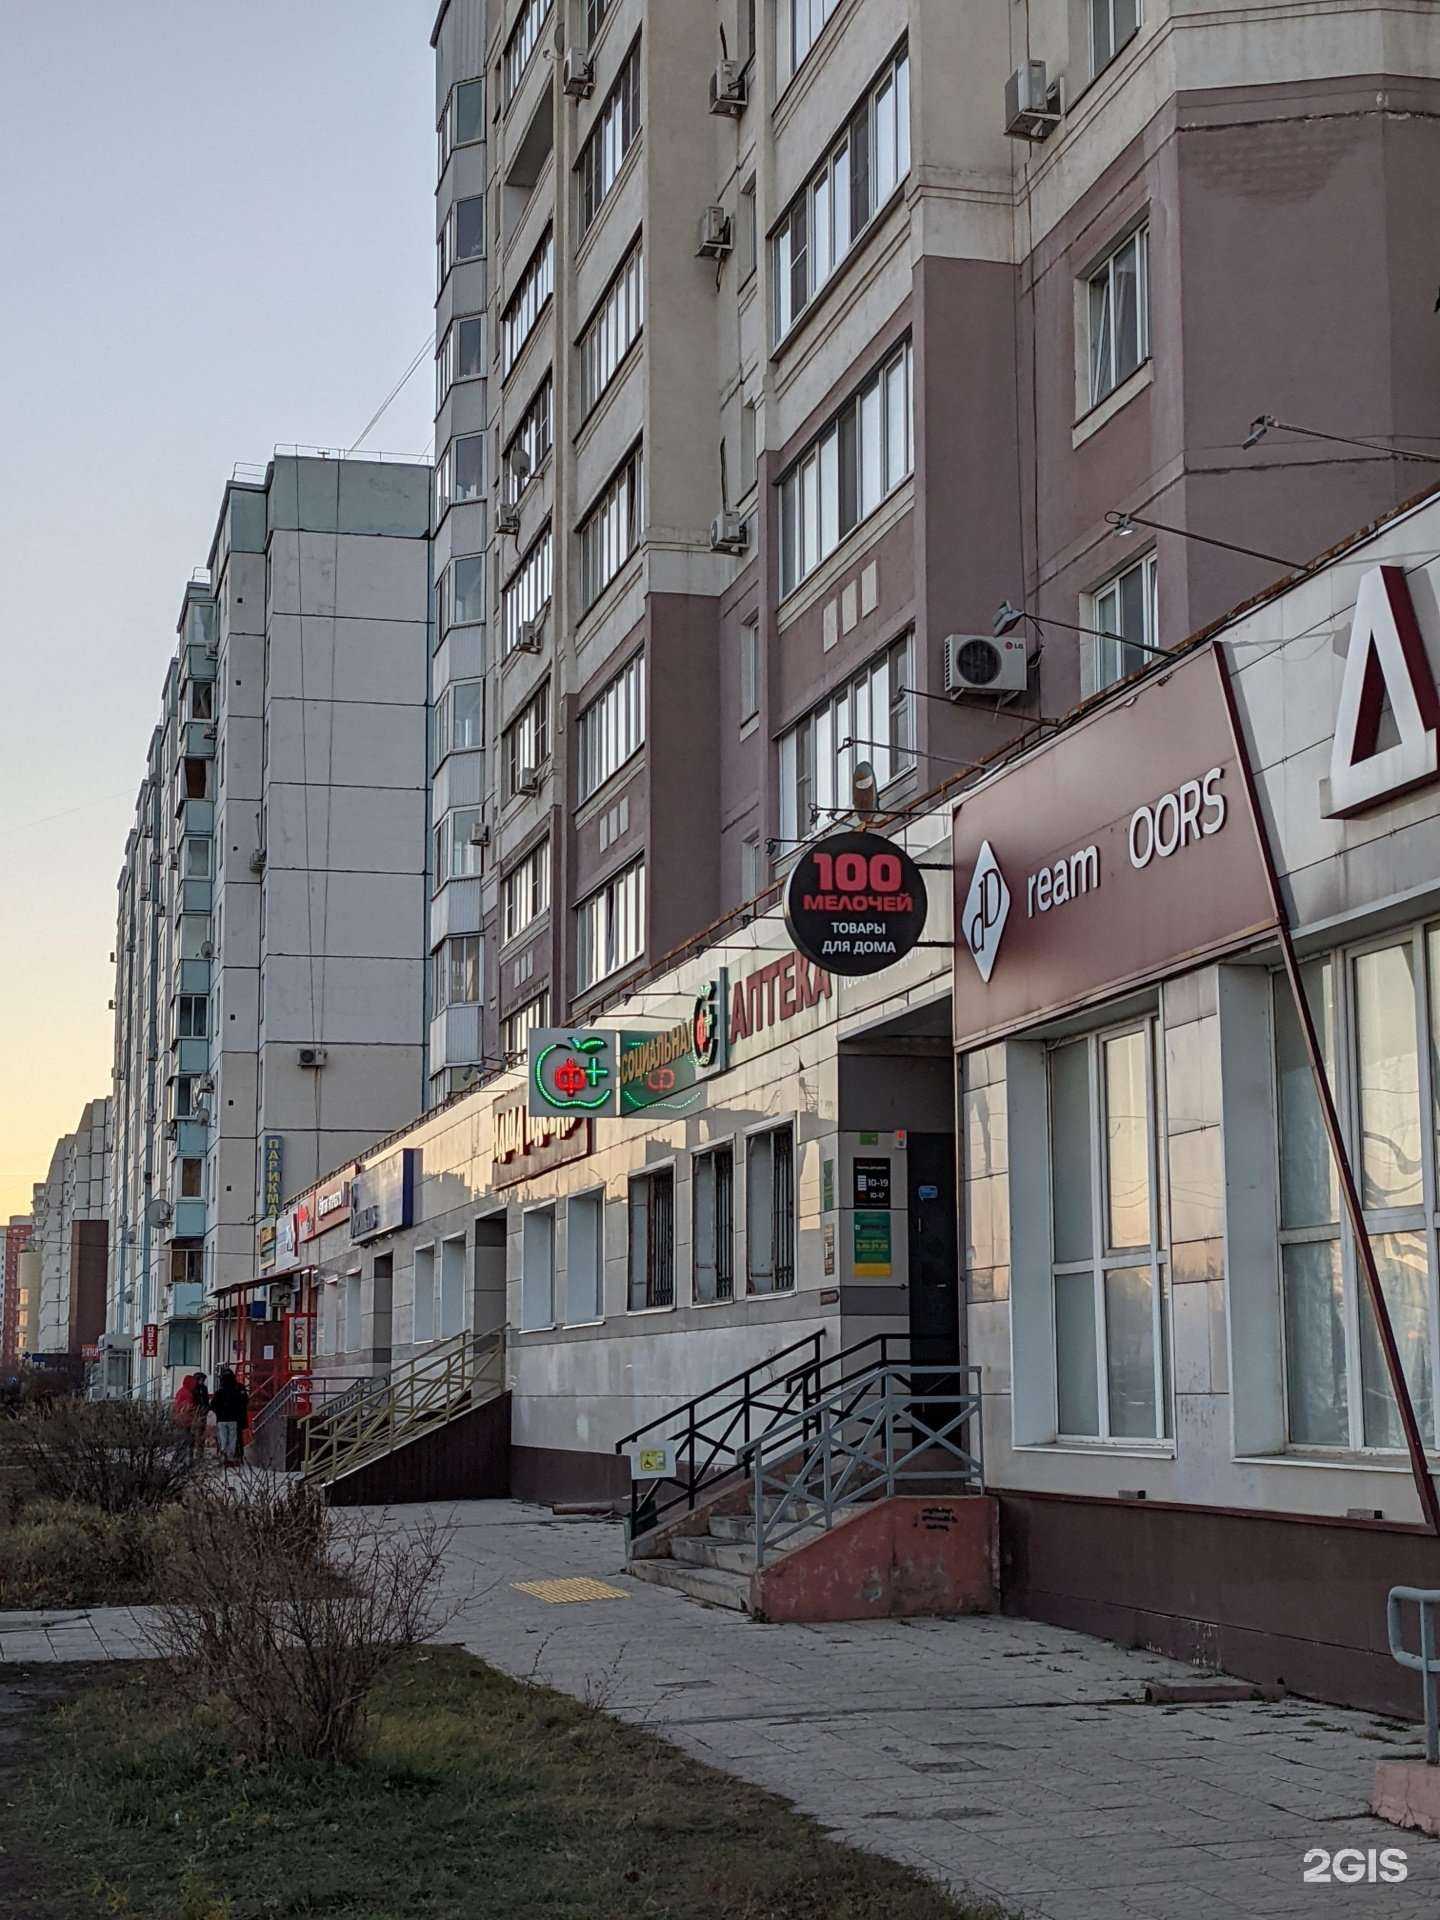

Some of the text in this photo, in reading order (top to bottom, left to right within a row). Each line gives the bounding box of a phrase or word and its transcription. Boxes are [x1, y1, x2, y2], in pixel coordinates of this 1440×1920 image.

[1014, 642, 1024, 650] LG
[1027, 845, 1100, 919] ream
[1129, 767, 1226, 869] OORS
[812, 852, 903, 893] 100
[803, 892, 914, 912] МЕЛОЧЕЙ
[830, 921, 887, 935] ТОВАРЫ
[822, 942, 897, 955] ДЛЯ ДОМА
[729, 950, 833, 1046] АПТЕКА
